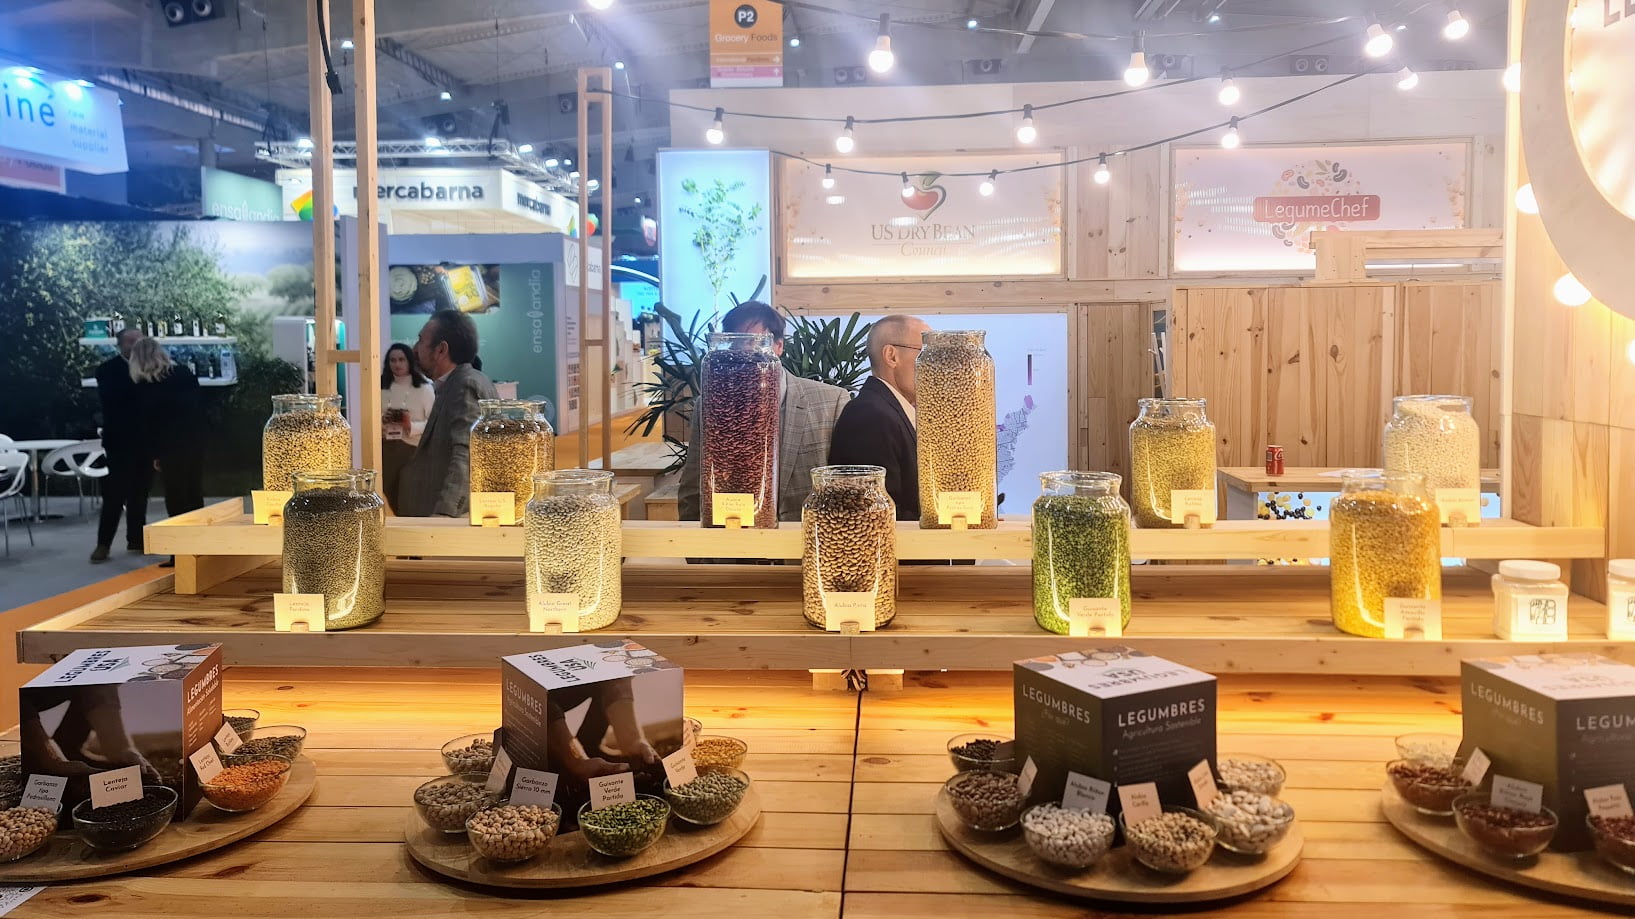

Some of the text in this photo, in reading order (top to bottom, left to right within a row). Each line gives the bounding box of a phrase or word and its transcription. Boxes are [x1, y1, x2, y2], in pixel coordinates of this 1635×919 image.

[738, 11, 754, 22] P2
[715, 34, 778, 43] Grocery Foods
[70, 124, 108, 139] material
[1264, 197, 1369, 222] LegumeChef
[871, 224, 976, 241] US DRY BEAN
[55, 650, 112, 683] LEGUMBRES
[90, 658, 124, 673] USA
[528, 654, 581, 683] LEGUMBRES
[560, 658, 589, 671] USA
[187, 664, 219, 703] LEGUMBRES
[1088, 669, 1189, 690] LEGUMBRES
[506, 679, 543, 715] LEGUMBRES
[1022, 684, 1091, 724] LEGUMBRES
[1471, 682, 1544, 725] LEGUMBRES
[1118, 699, 1206, 728] LEGUMBRES
[1122, 716, 1201, 740] Agricultura Sostenible
[103, 776, 128, 786] Lenteja
[105, 784, 128, 792] Caviar
[522, 777, 548, 787] Garbanzo
[598, 780, 624, 788] Guisante
